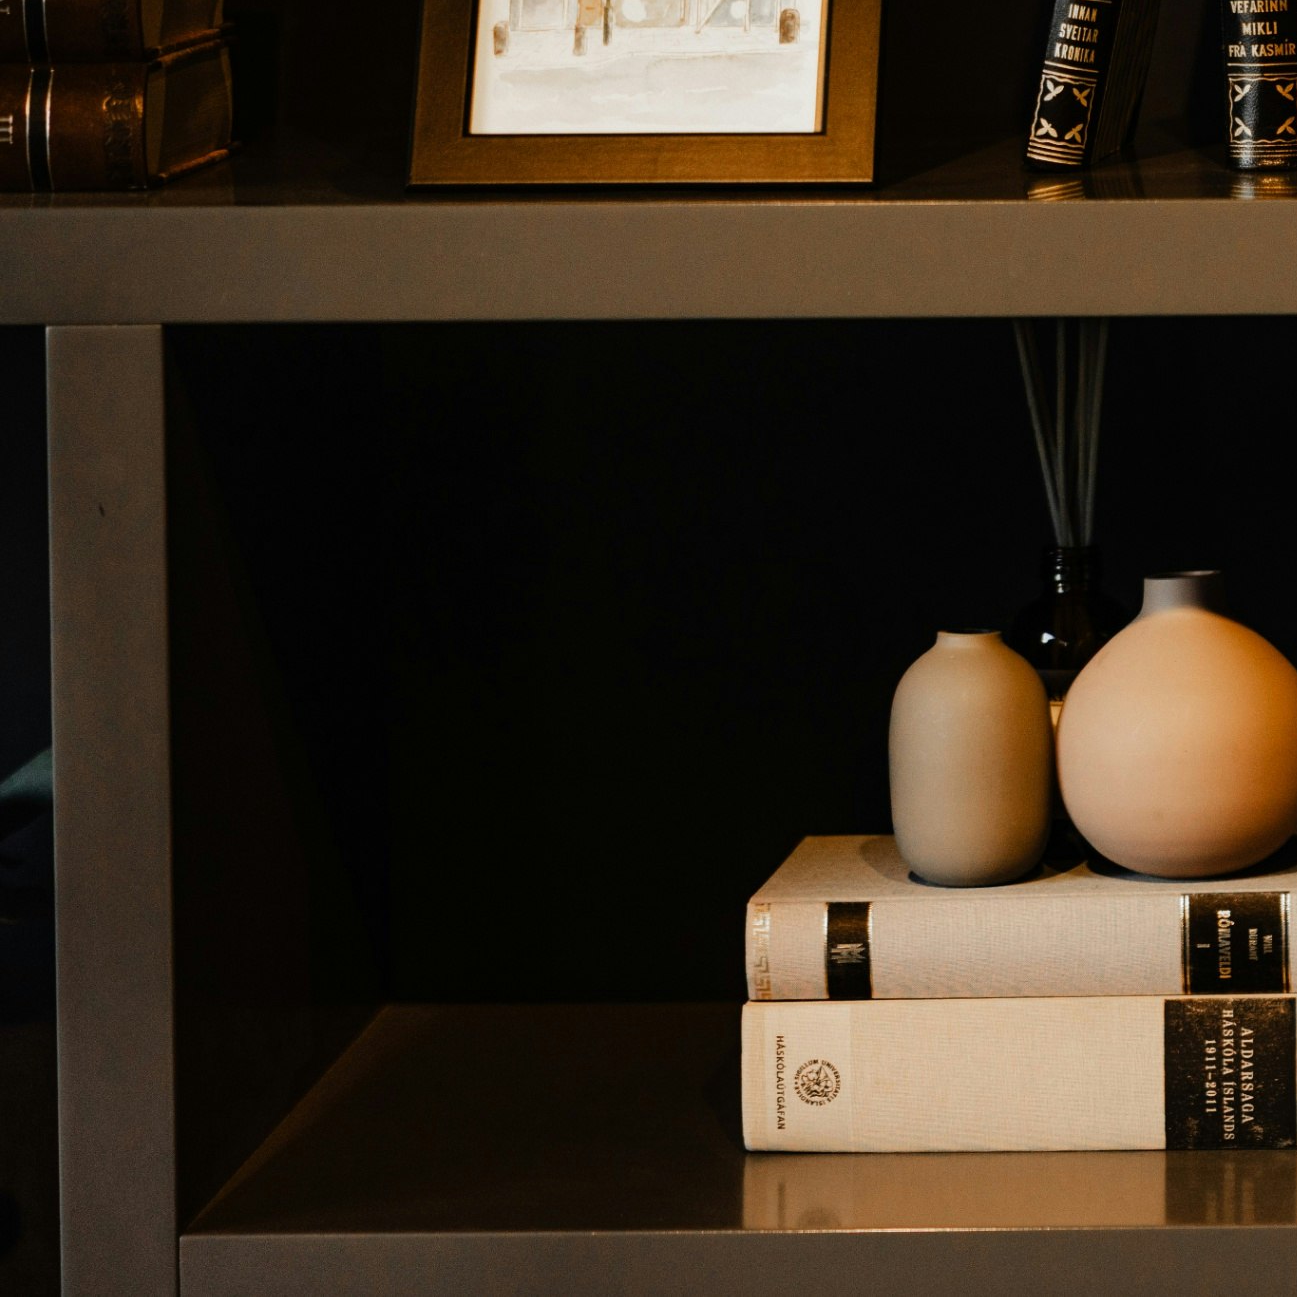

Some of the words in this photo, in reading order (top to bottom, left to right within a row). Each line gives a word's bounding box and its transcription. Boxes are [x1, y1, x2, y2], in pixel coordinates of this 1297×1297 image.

[1058, 22, 1100, 44] SVEITAR
[1068, 2, 1098, 23] INNAN
[1242, 21, 1278, 36] MIKLI
[1053, 42, 1096, 64] KRONIKA
[1228, 40, 1247, 57] FRÁ
[1251, 37, 1297, 57] KASMÍR
[1216, 909, 1235, 980] RÓMAVELDI
[1222, 1008, 1236, 1076] HÁSKÓLA
[775, 1034, 786, 1131] HÁSKÓLAÚTGÁFAN
[1204, 1039, 1217, 1114] 1911-2011
[1239, 1026, 1255, 1124] ALDARSAGA
[1222, 1079, 1235, 1141] ÍSLANDS
